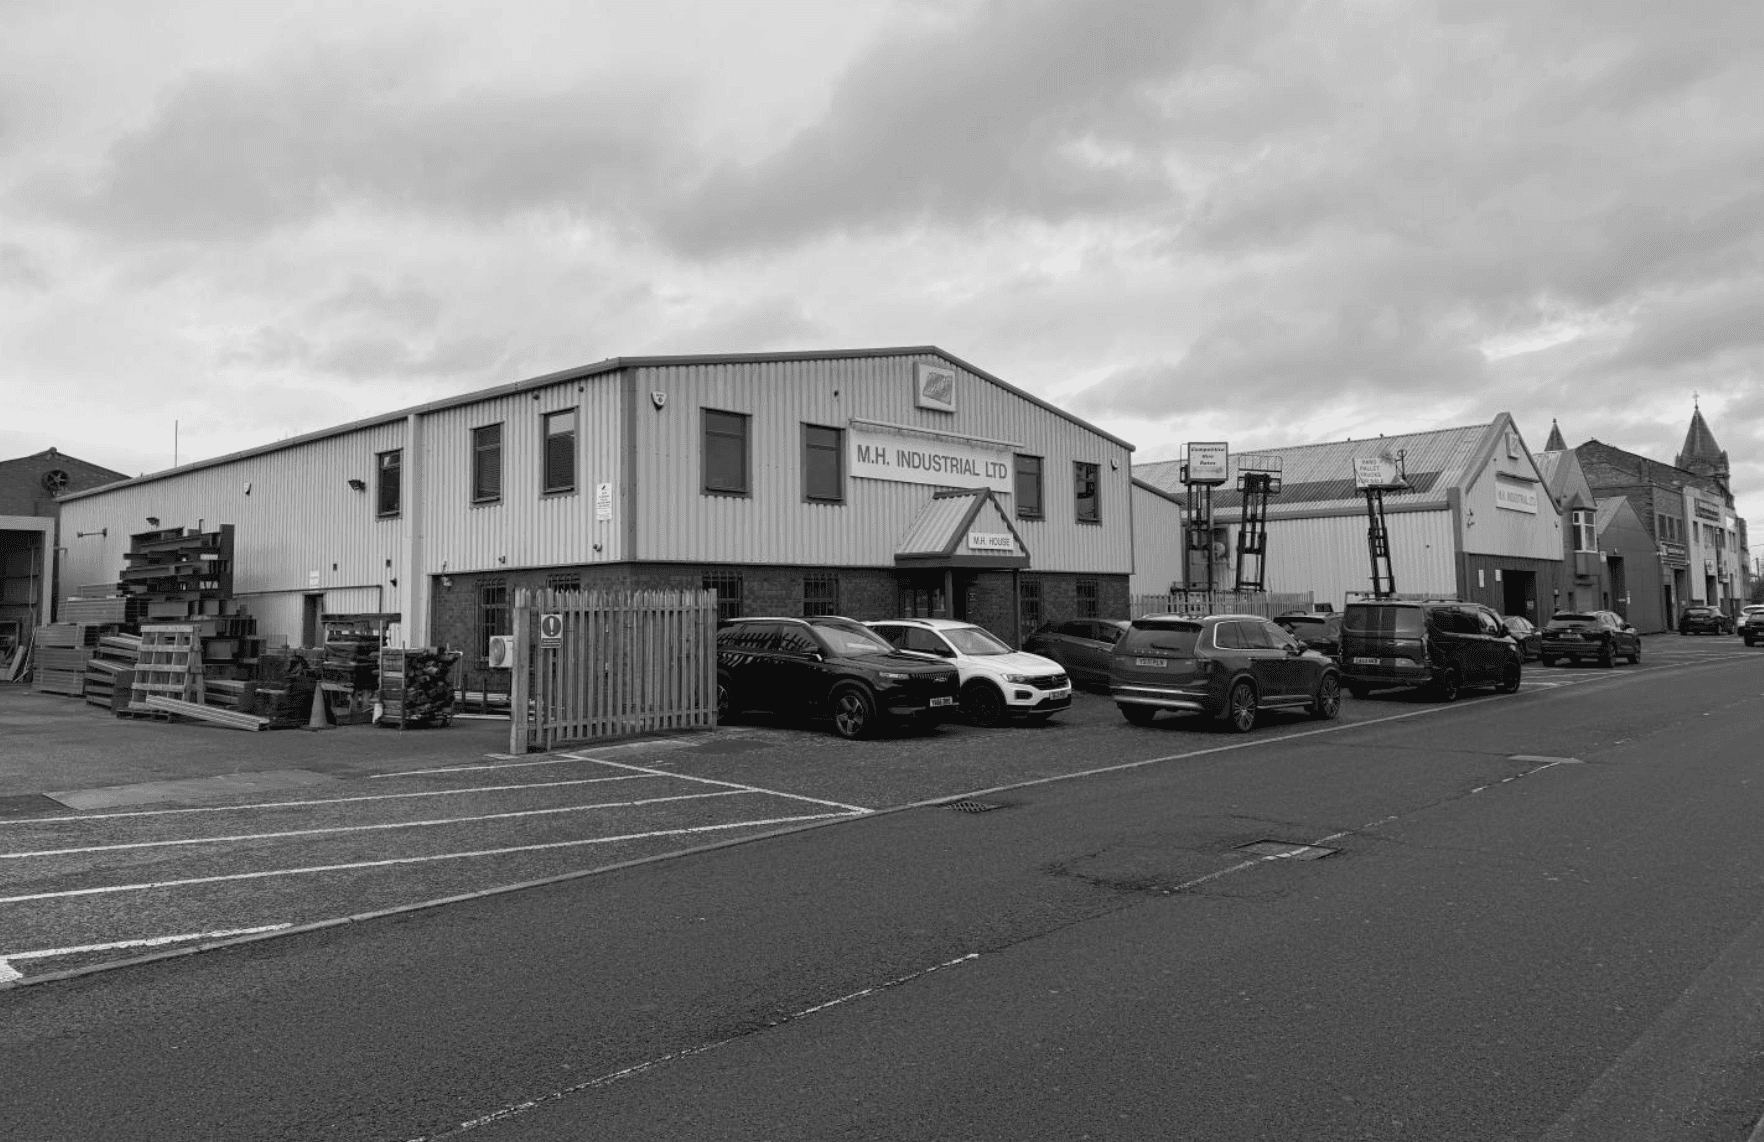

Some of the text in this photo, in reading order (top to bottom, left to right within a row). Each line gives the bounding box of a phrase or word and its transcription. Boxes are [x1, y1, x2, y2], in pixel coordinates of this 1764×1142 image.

[858, 445, 1008, 479] M.H. INDUSTRIAL LTD
[989, 536, 1011, 546] HOUSE
